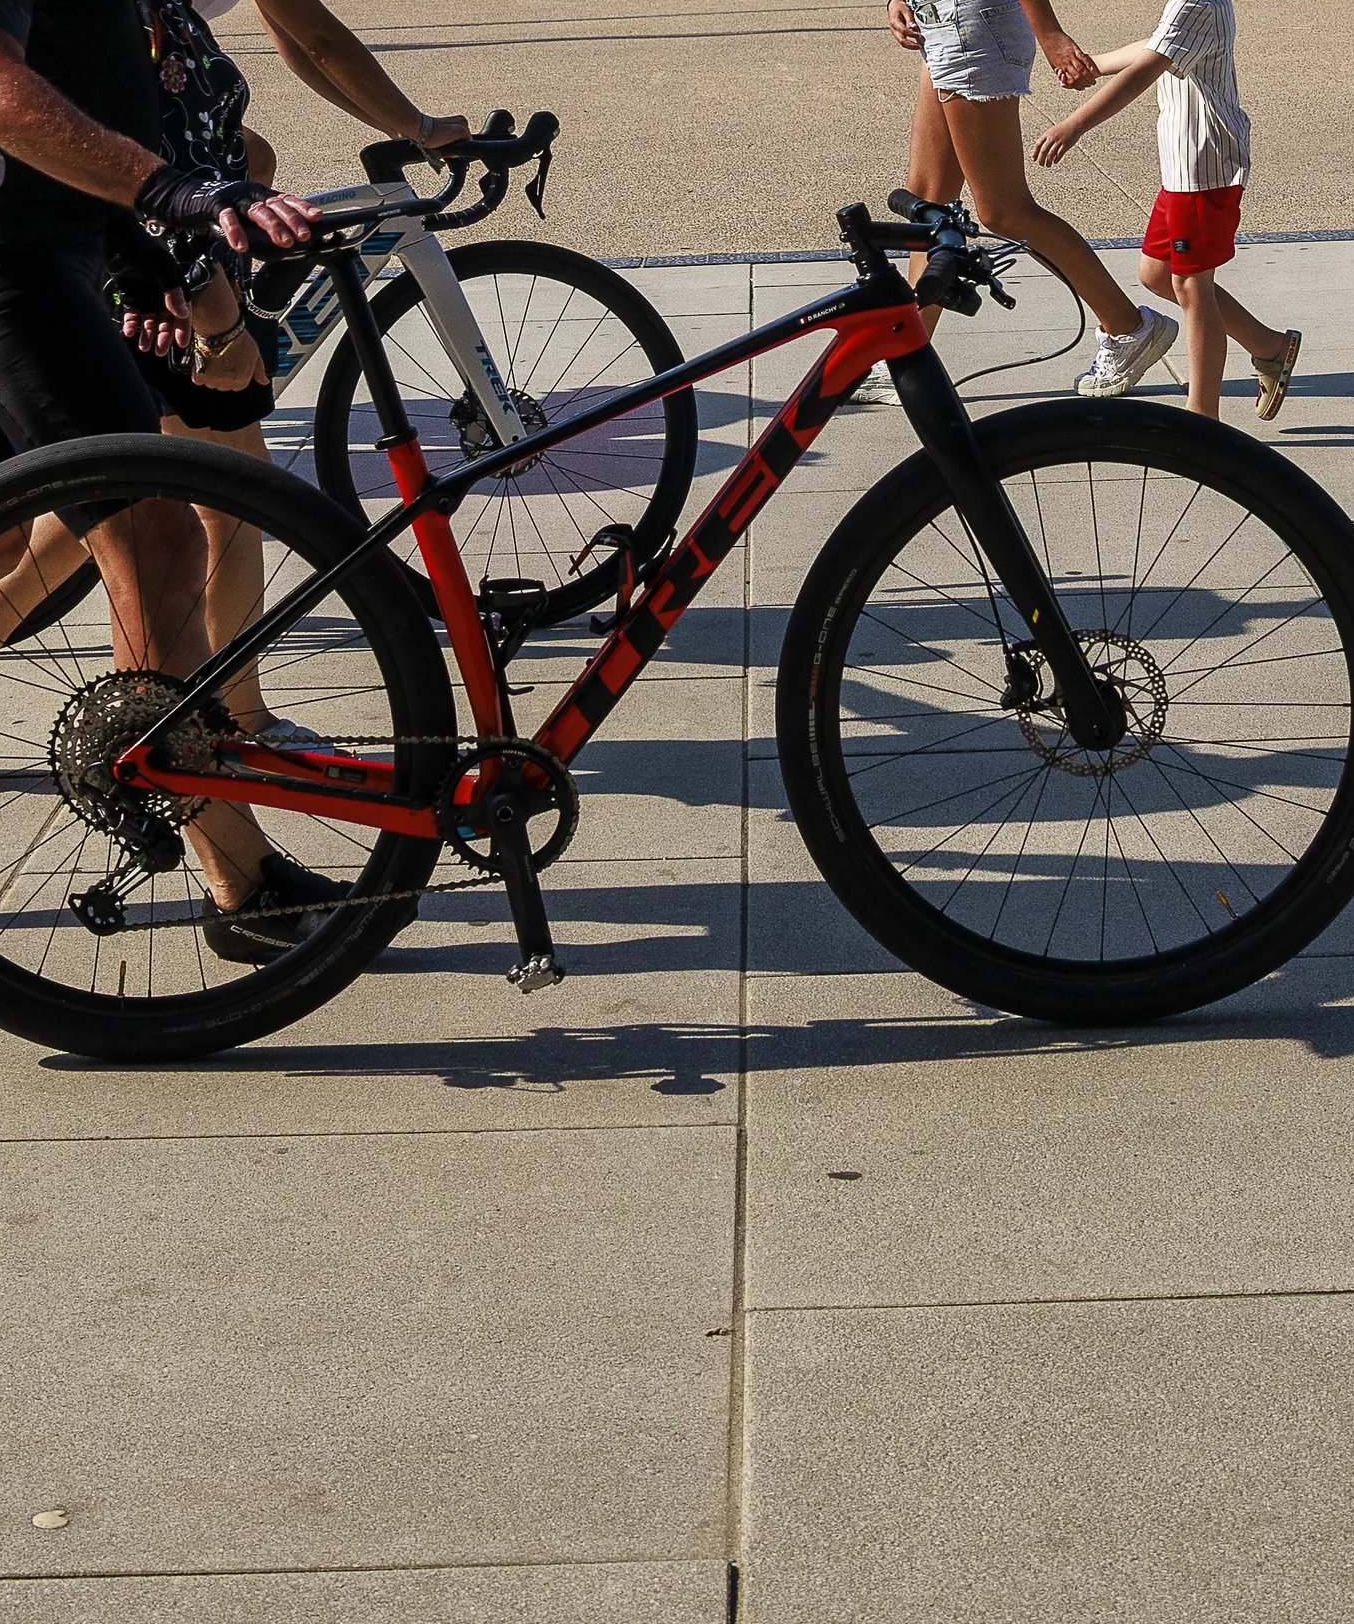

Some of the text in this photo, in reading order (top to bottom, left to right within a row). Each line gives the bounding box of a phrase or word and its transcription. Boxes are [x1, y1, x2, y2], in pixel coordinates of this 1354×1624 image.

[318, 190, 356, 206] RACING
[807, 305, 837, 321] D.RANCHY
[475, 339, 516, 415] TREK
[6, 480, 64, 506] G-ONE
[813, 606, 837, 666] G-ONE
[810, 741, 846, 843] SCHWALBE
